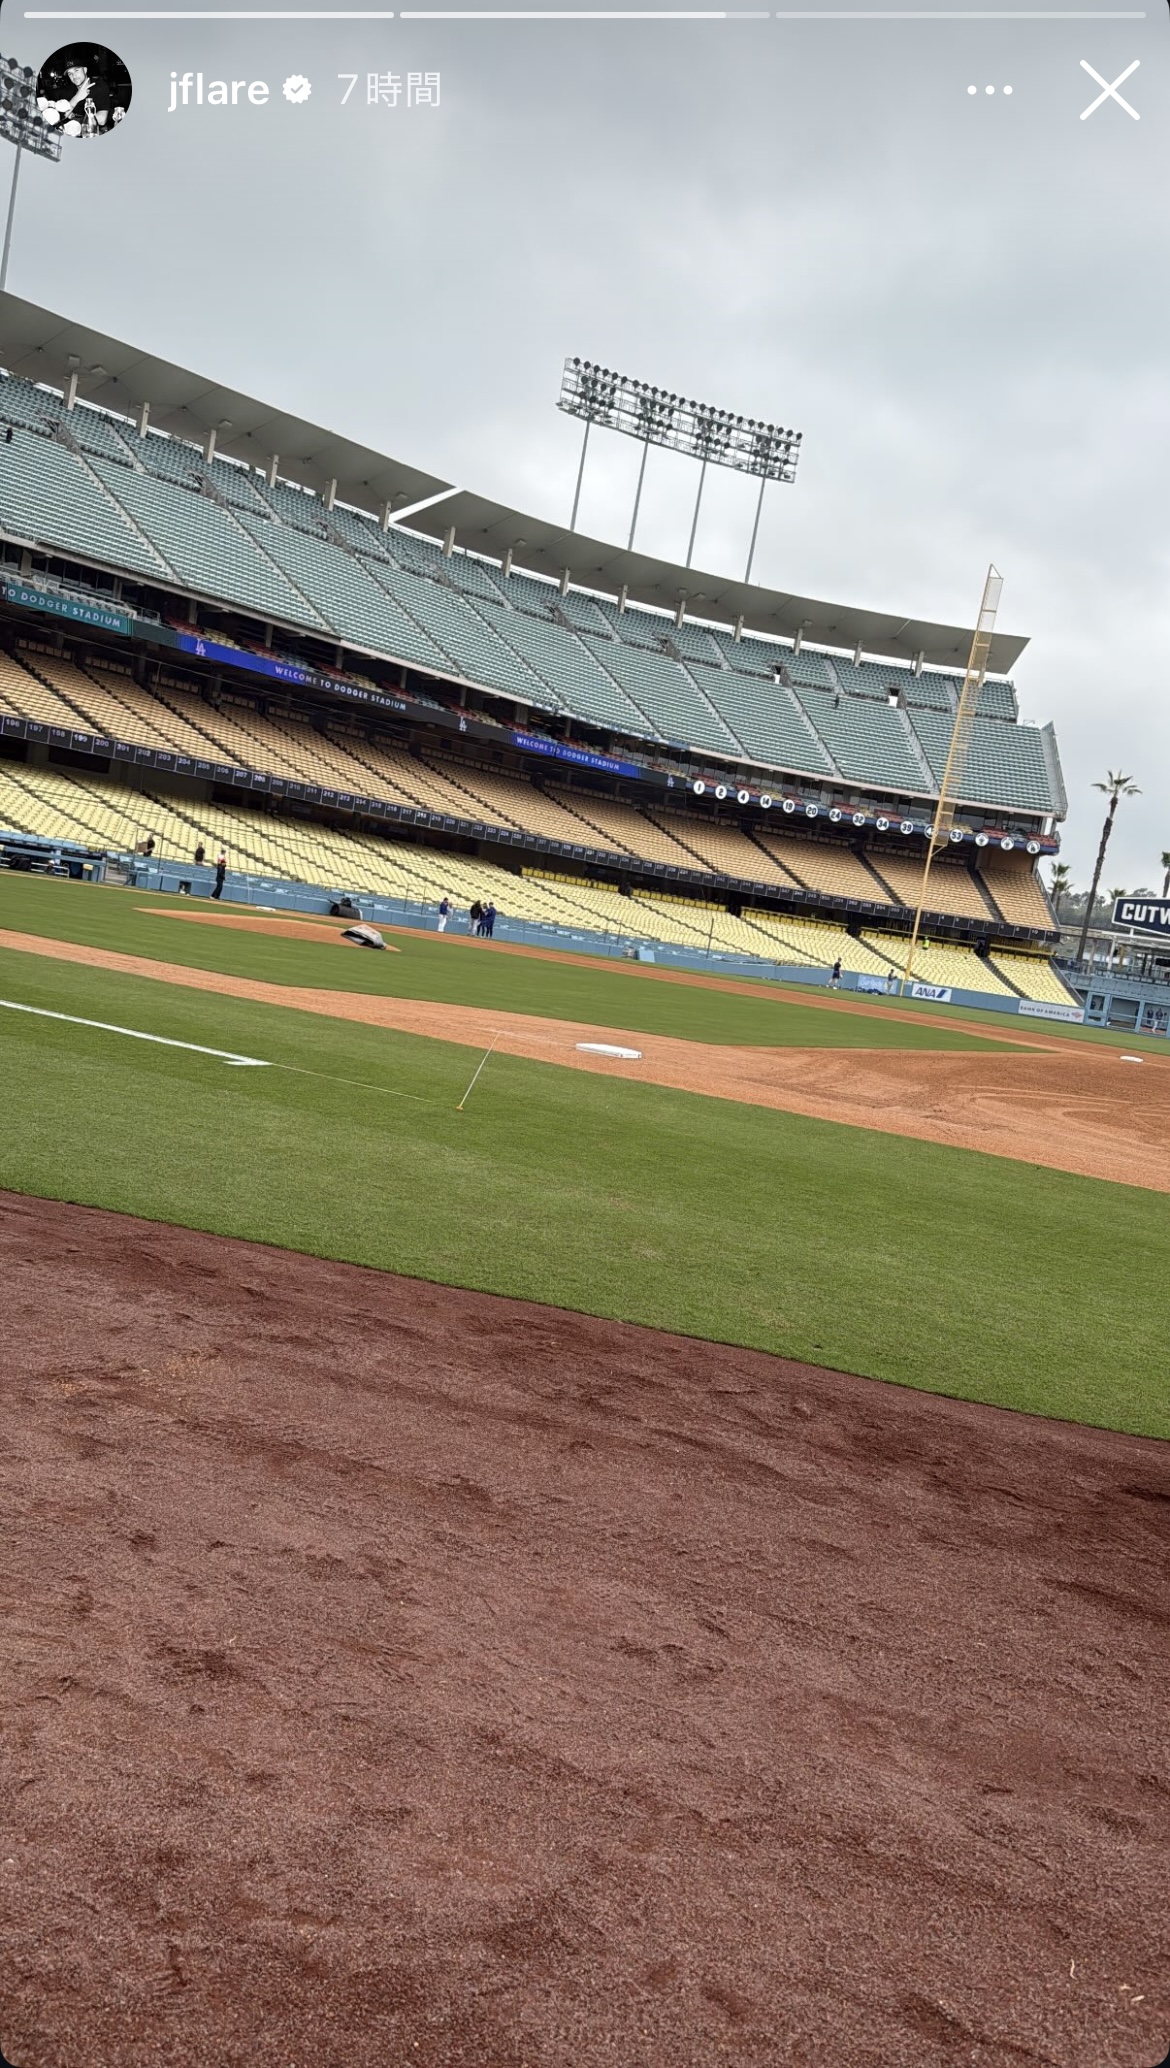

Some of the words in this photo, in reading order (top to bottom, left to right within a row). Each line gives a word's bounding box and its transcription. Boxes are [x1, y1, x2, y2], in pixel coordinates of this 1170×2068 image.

[1, 586, 16, 597] TO
[21, 592, 68, 613] DODGER
[73, 607, 121, 628] STADIUM
[275, 666, 317, 685] WELCOME
[320, 679, 331, 689] TO
[334, 684, 368, 700] DODGER
[371, 694, 406, 711] STADIUM
[516, 736, 548, 751] WELCOME
[562, 749, 589, 762] DODGER
[591, 757, 620, 771] STADIUM
[762, 797, 771, 806] 14
[785, 802, 794, 811] 19
[807, 806, 817, 815] 20
[831, 811, 841, 820] 24
[854, 815, 864, 825] 32
[878, 819, 888, 828] 34
[902, 823, 912, 832] 39
[951, 831, 961, 840] 53
[1121, 902, 1170, 926] CUTW
[915, 986, 936, 998] ANA
[1020, 1005, 1036, 1013] BANK
[1044, 1009, 1070, 1018] AMERICA
